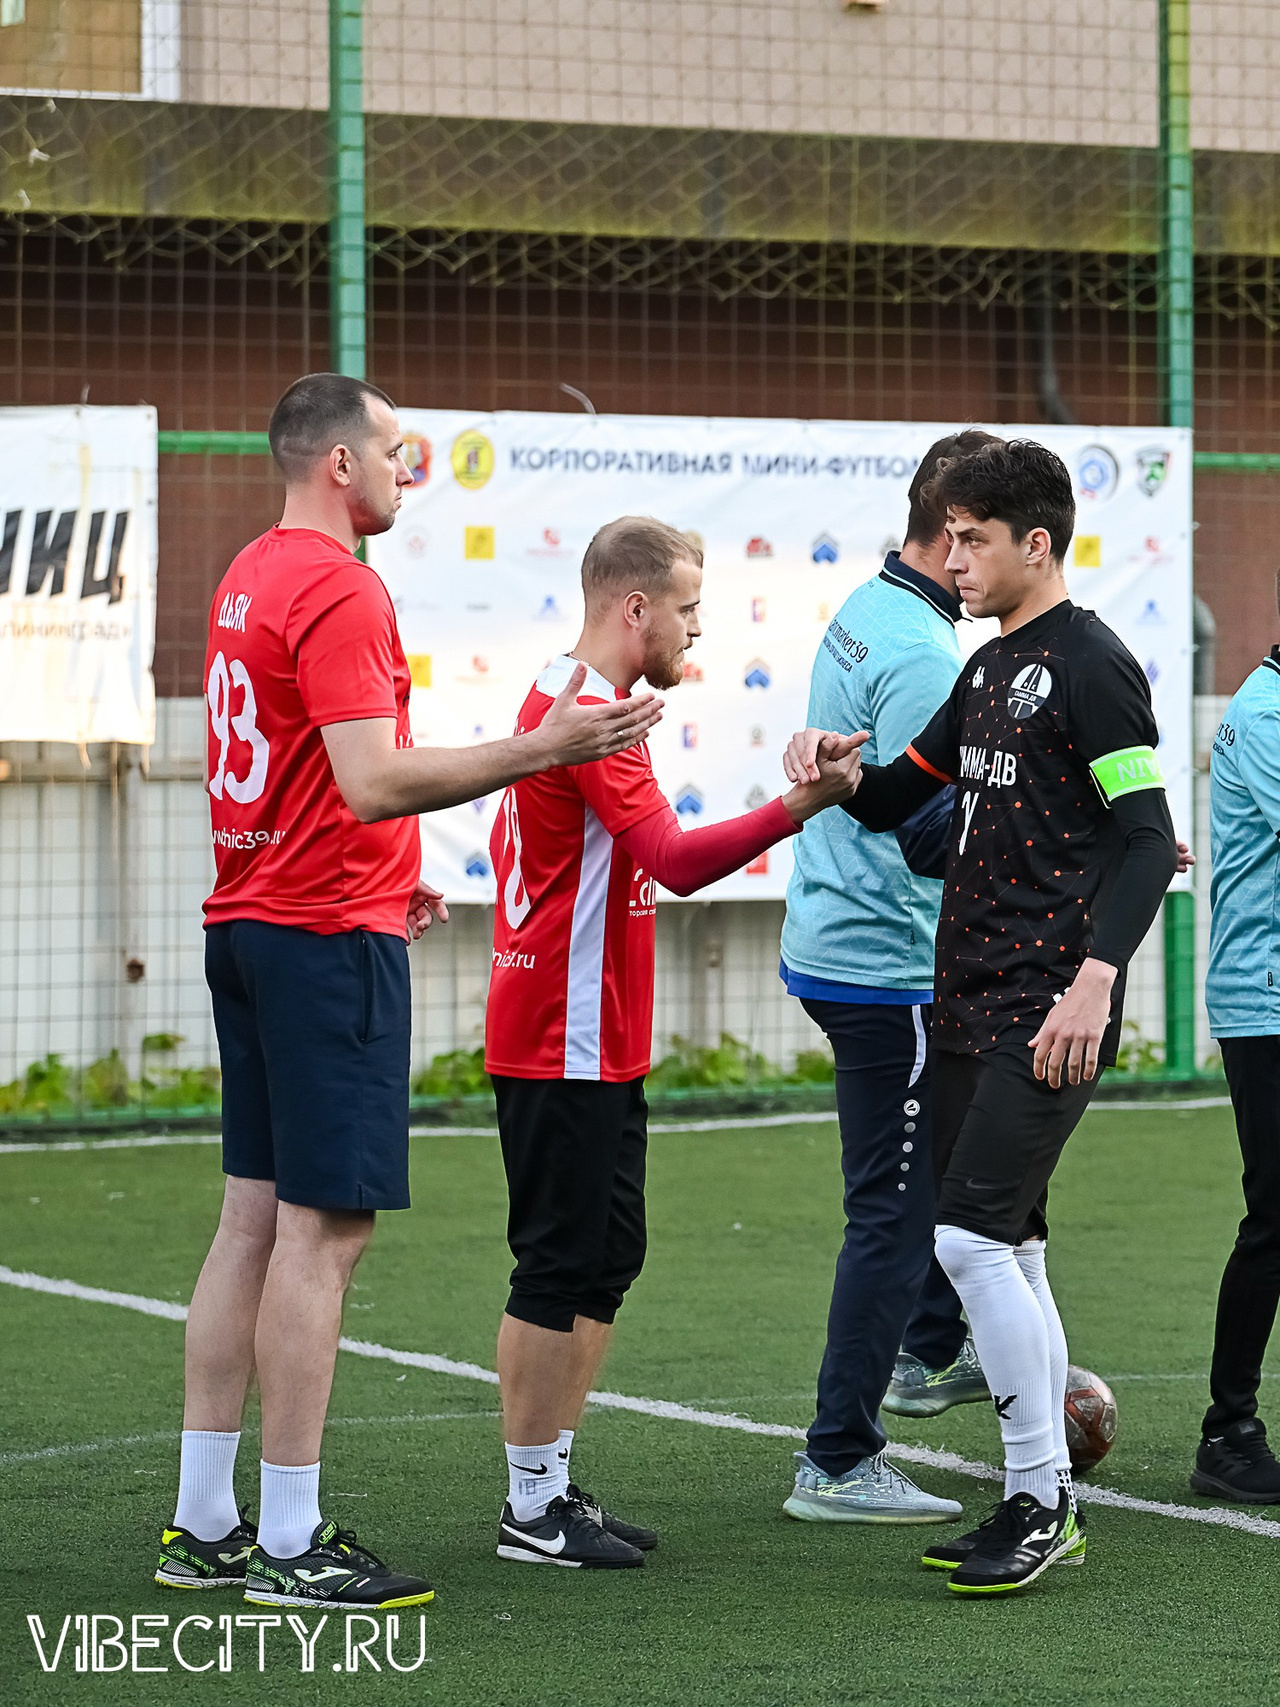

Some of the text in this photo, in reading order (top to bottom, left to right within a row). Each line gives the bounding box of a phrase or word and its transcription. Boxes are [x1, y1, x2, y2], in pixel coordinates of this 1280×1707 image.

[510, 448, 732, 474] КОРПОРАТИВНАЯ
[218, 592, 252, 633] ДЬЯК
[208, 651, 270, 804] 93
